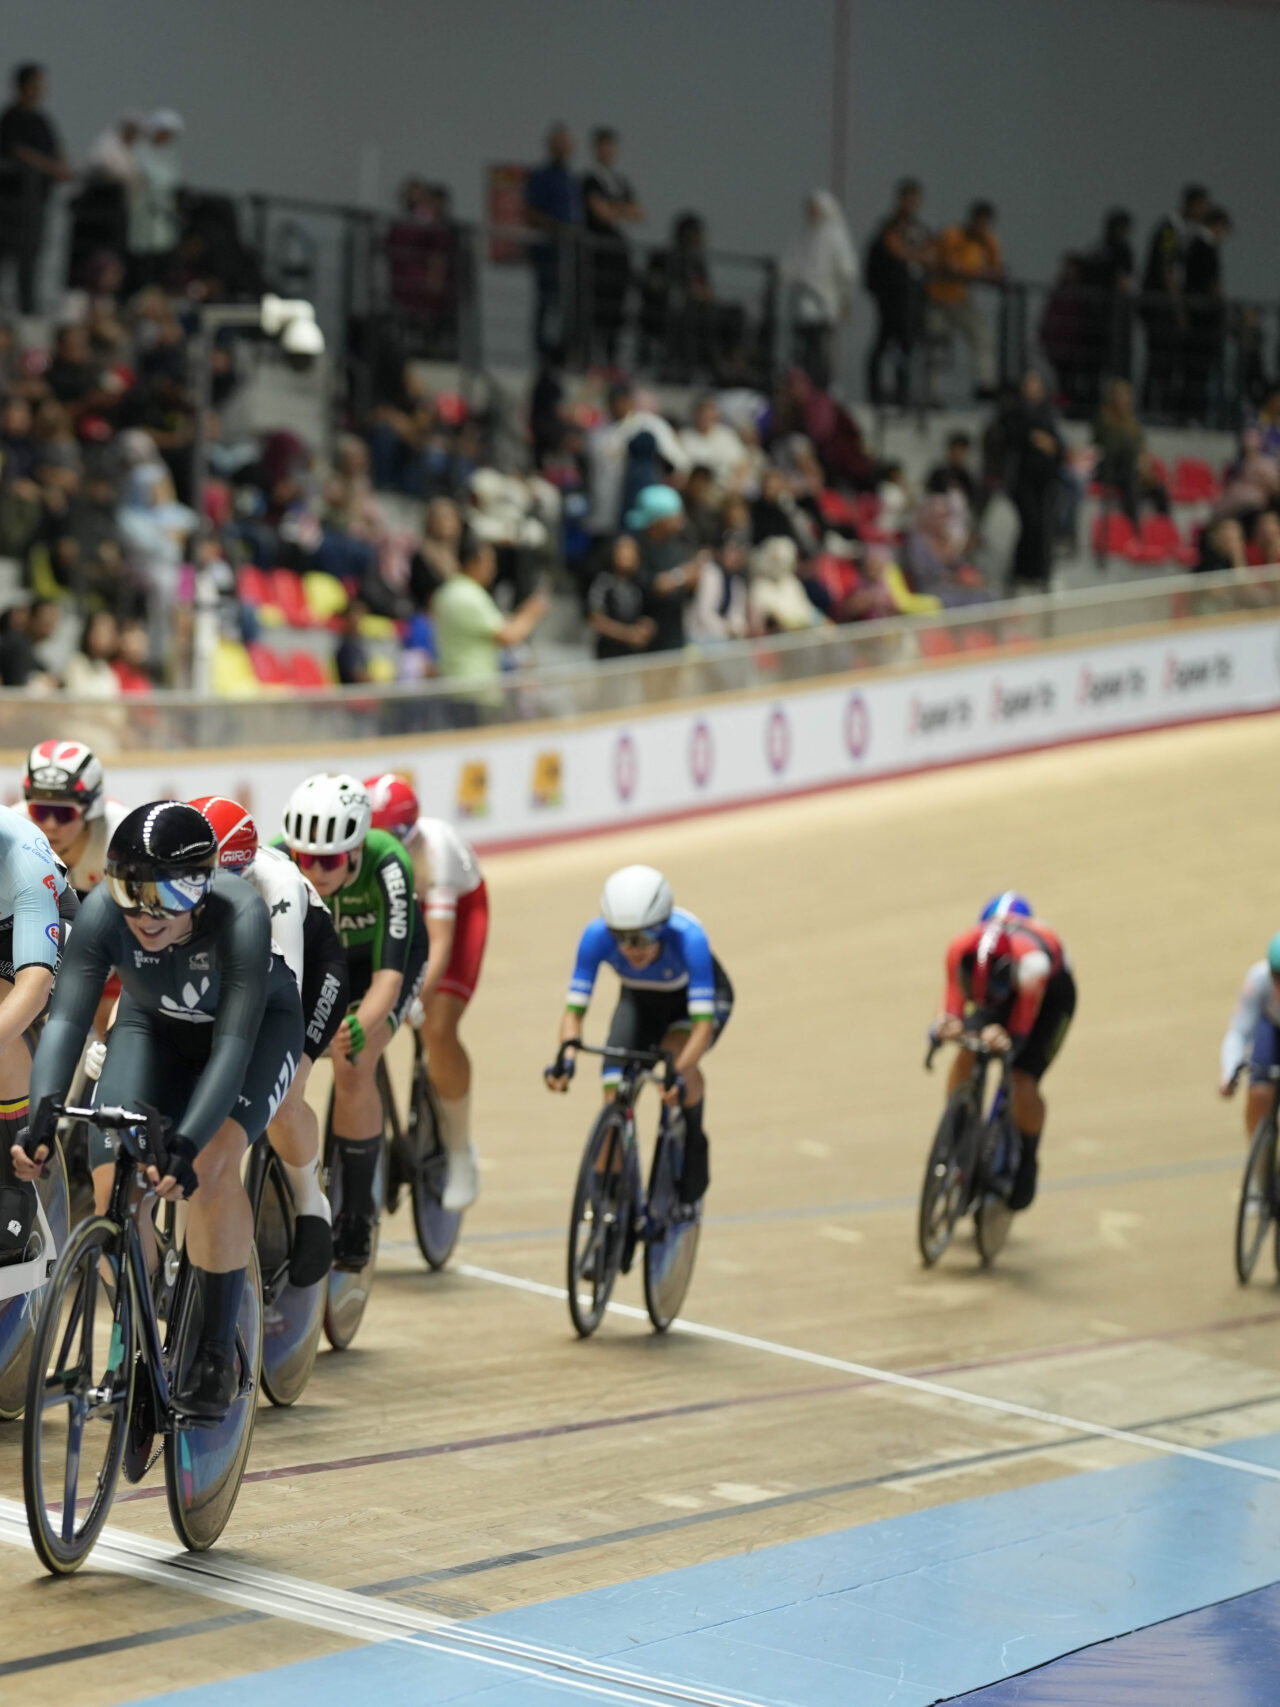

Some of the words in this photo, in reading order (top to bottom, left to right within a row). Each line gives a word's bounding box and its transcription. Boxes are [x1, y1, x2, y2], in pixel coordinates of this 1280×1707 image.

[221, 849, 253, 862] GIRO
[381, 861, 408, 940] IRELAND
[306, 972, 341, 1045] EVIDEN
